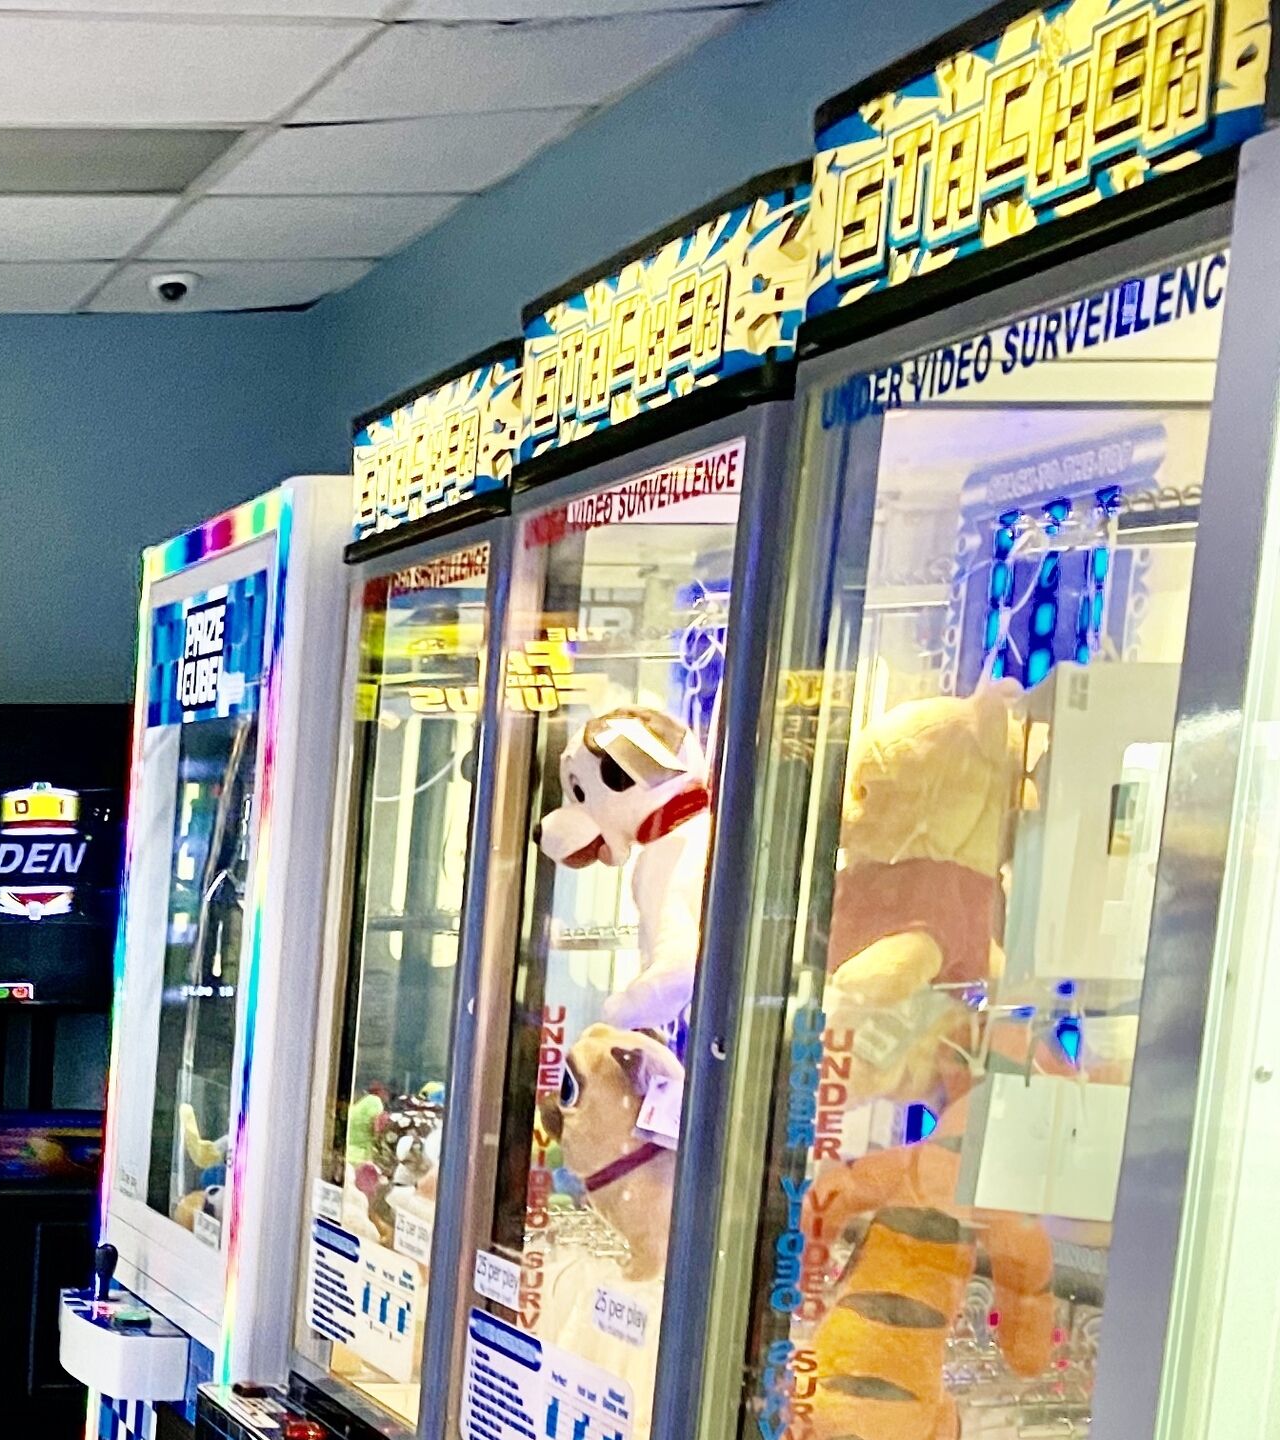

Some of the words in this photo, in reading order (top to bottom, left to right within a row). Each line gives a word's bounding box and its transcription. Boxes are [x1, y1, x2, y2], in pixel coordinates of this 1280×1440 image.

[834, 2, 1212, 281] STACKER
[532, 263, 730, 436] STACKER
[822, 364, 902, 429] UNDER
[911, 334, 992, 401] VIDEO
[1001, 254, 1227, 375] SURVEILLENC
[359, 408, 480, 524] STACKER
[569, 491, 613, 532] VIDEO
[617, 448, 739, 521] SURVEILLENCE
[181, 656, 219, 707] CUBE
[184, 604, 227, 660] PRIZE
[812, 1028, 855, 1162] UNDER
[488, 1260, 502, 1286] per
[502, 1265, 518, 1292] play
[797, 1188, 841, 1323] VIDEO
[608, 1296, 627, 1320] per
[628, 1301, 648, 1334] play
